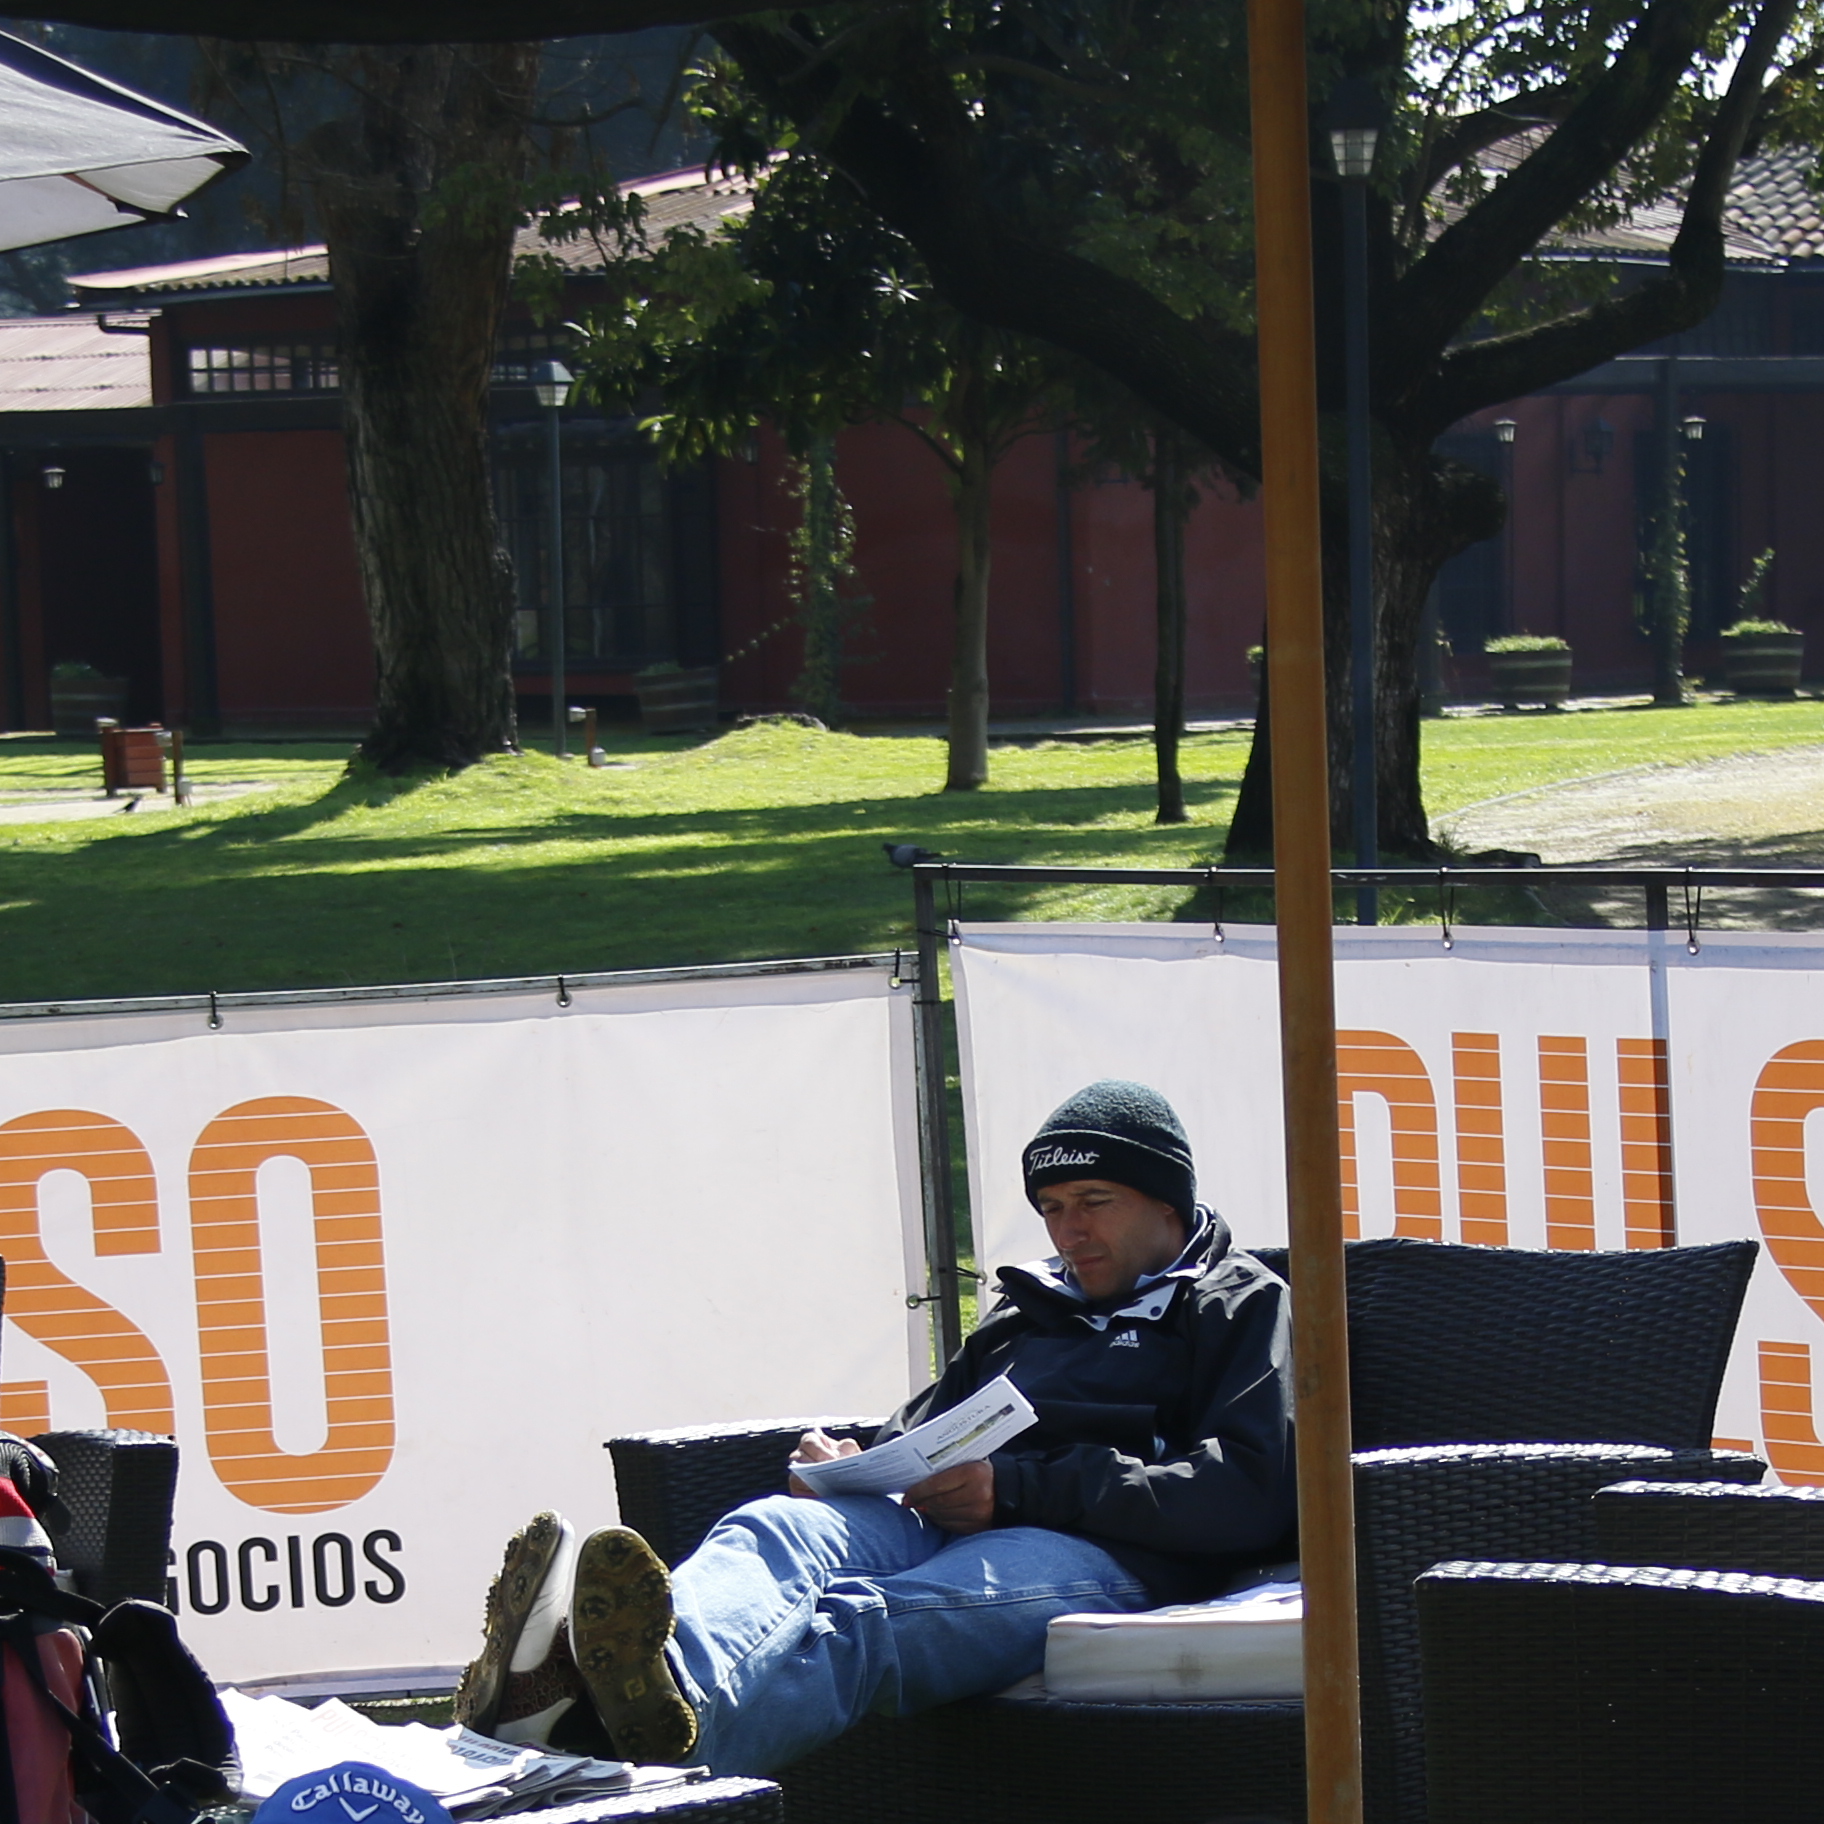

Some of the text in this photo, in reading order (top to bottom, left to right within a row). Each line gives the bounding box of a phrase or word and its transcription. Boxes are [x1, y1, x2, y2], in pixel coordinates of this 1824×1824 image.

[1028, 1144, 1100, 1176] Titleist
[164, 1529, 407, 1616] OCIOS
[291, 1770, 426, 1824] Callaway
